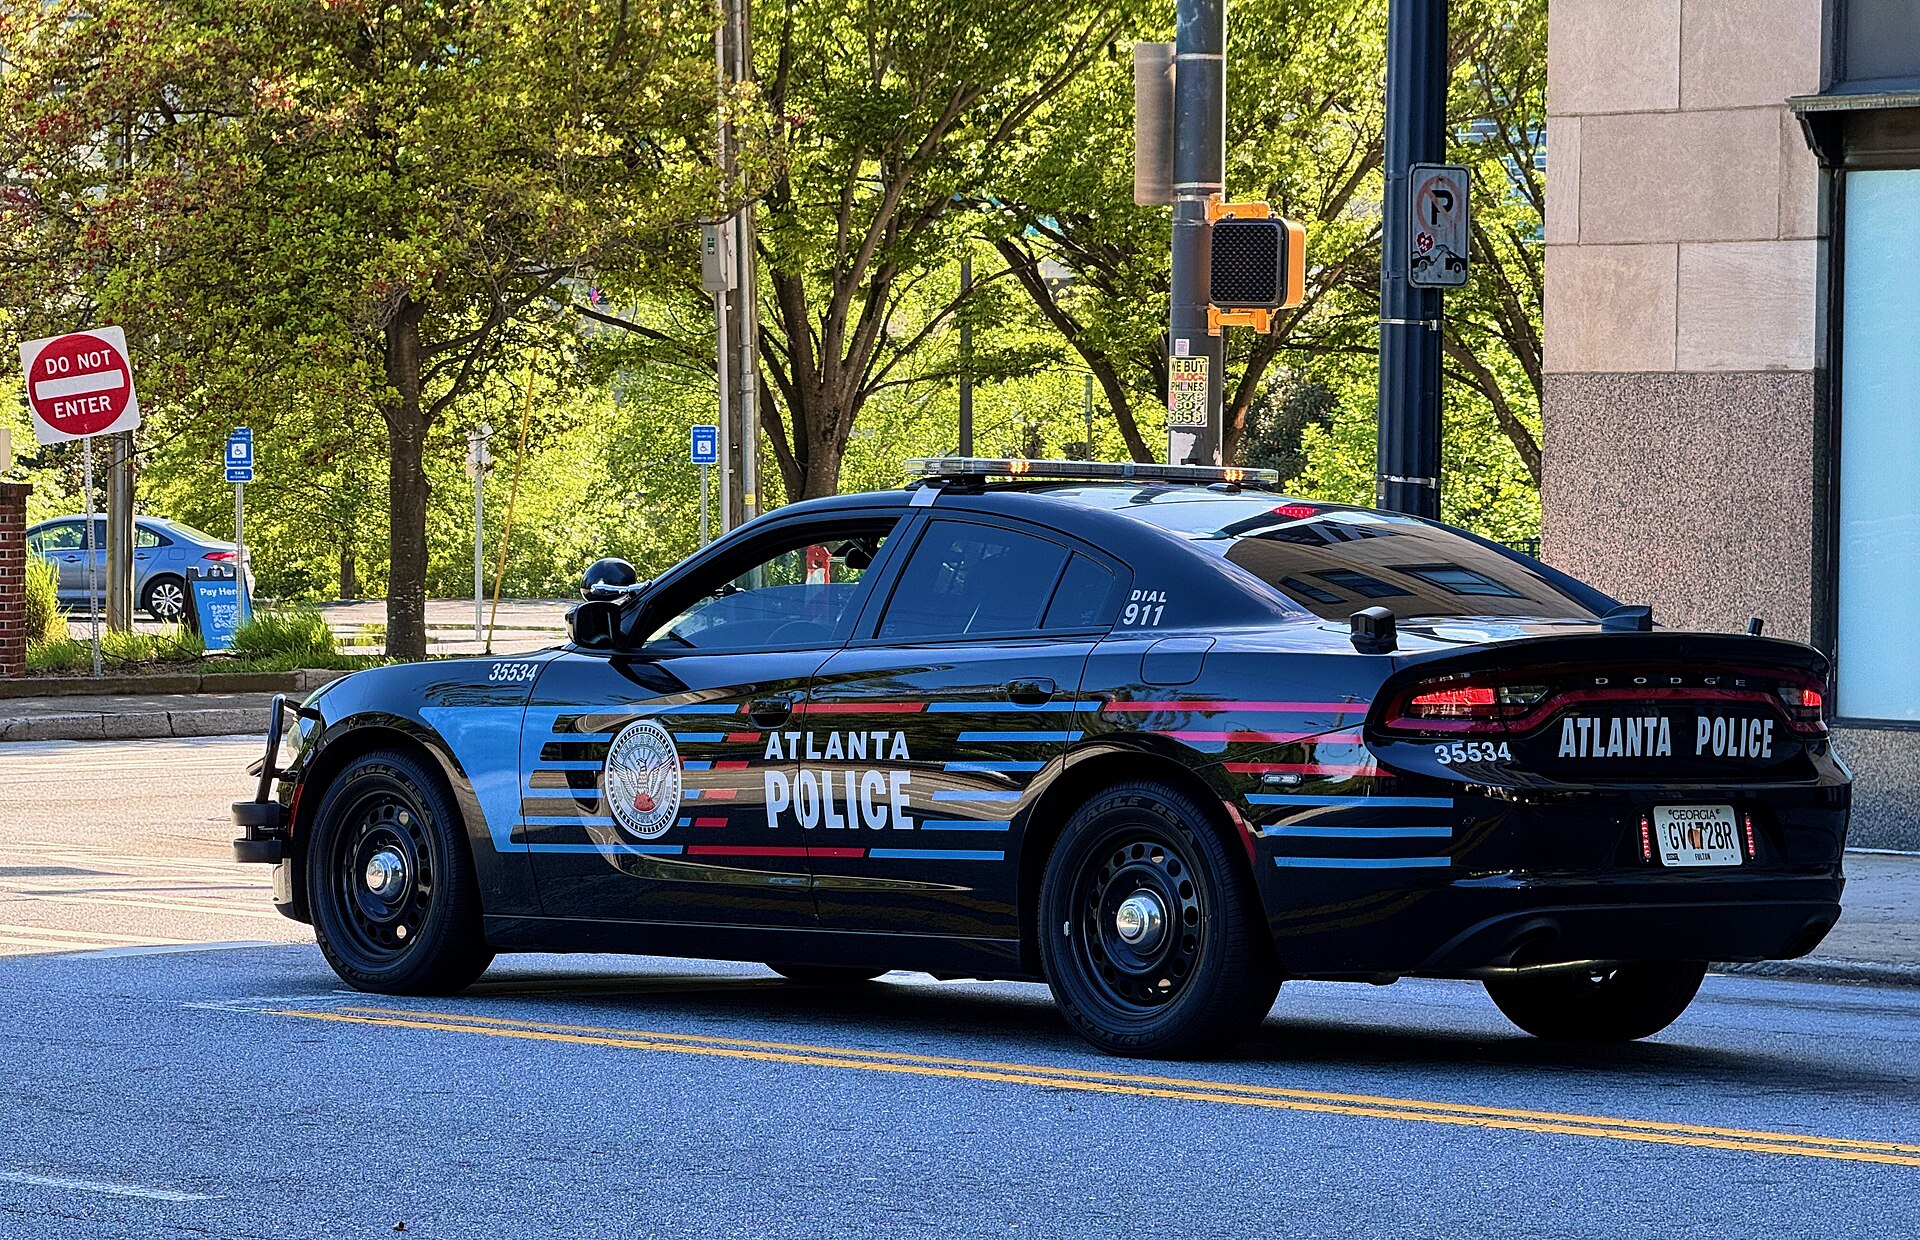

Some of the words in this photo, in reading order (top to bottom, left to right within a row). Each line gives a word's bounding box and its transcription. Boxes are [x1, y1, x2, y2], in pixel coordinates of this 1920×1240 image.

[45, 356, 70, 375] DO
[77, 349, 111, 370] NOT
[1184, 361, 1205, 372] BUY
[1171, 382, 1204, 391] PHNES
[54, 395, 112, 419] ENTER
[200, 587, 217, 598] Pay
[219, 587, 237, 596] Her
[1131, 589, 1167, 603] DIAL
[1123, 603, 1164, 626] 911
[489, 662, 539, 682] 35534
[1595, 676, 1746, 687] DODGE
[764, 731, 910, 760] ATLANTA
[1559, 716, 1672, 758] ATLANTA
[1695, 716, 1774, 758] POLICE
[1434, 741, 1512, 764] 35534
[764, 769, 914, 830] POLICE
[1672, 809, 1717, 821] GEORGIA
[1668, 821, 1735, 850] GV1728R
[1694, 852, 1712, 861] FULTON
